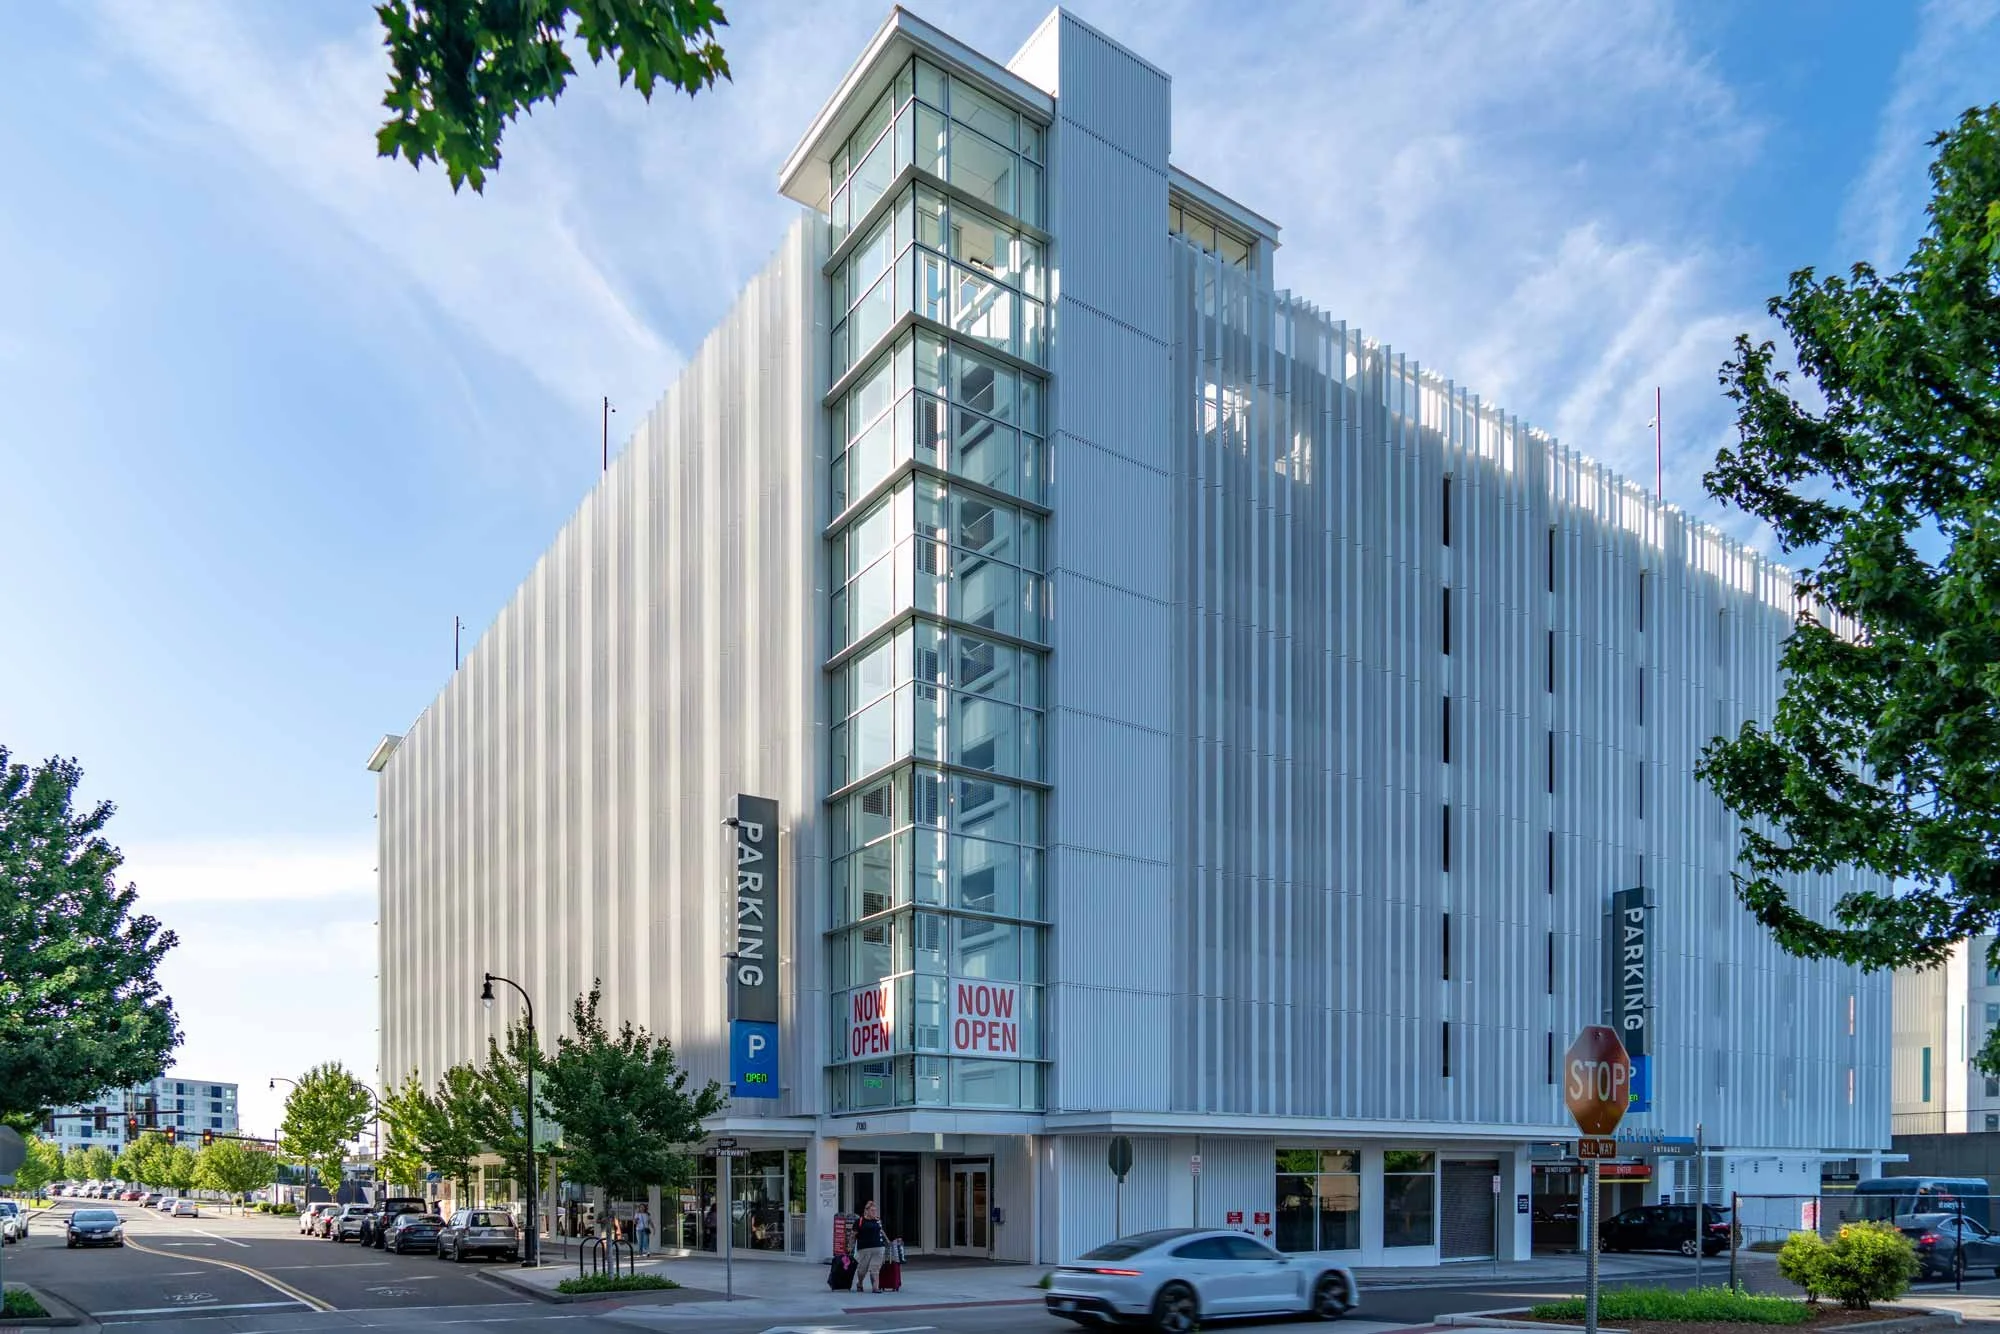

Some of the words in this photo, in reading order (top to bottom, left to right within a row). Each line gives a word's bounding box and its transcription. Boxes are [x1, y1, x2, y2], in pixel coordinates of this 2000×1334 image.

[738, 821, 763, 987] PARKING
[1624, 907, 1644, 1031] PARKING
[854, 986, 888, 1022] NOW
[958, 984, 1015, 1018] NOW
[749, 1035, 766, 1058] P
[852, 1022, 889, 1056] OPEN
[955, 1019, 1017, 1053] OPEN
[1569, 1060, 1625, 1102] STOP
[1581, 1142, 1596, 1155] ALL
[1599, 1142, 1613, 1155] WAY
[1617, 1127, 1665, 1144] ARKING
[1653, 1145, 1681, 1153] ENTRANCE
[1617, 1166, 1632, 1174] ENTER
